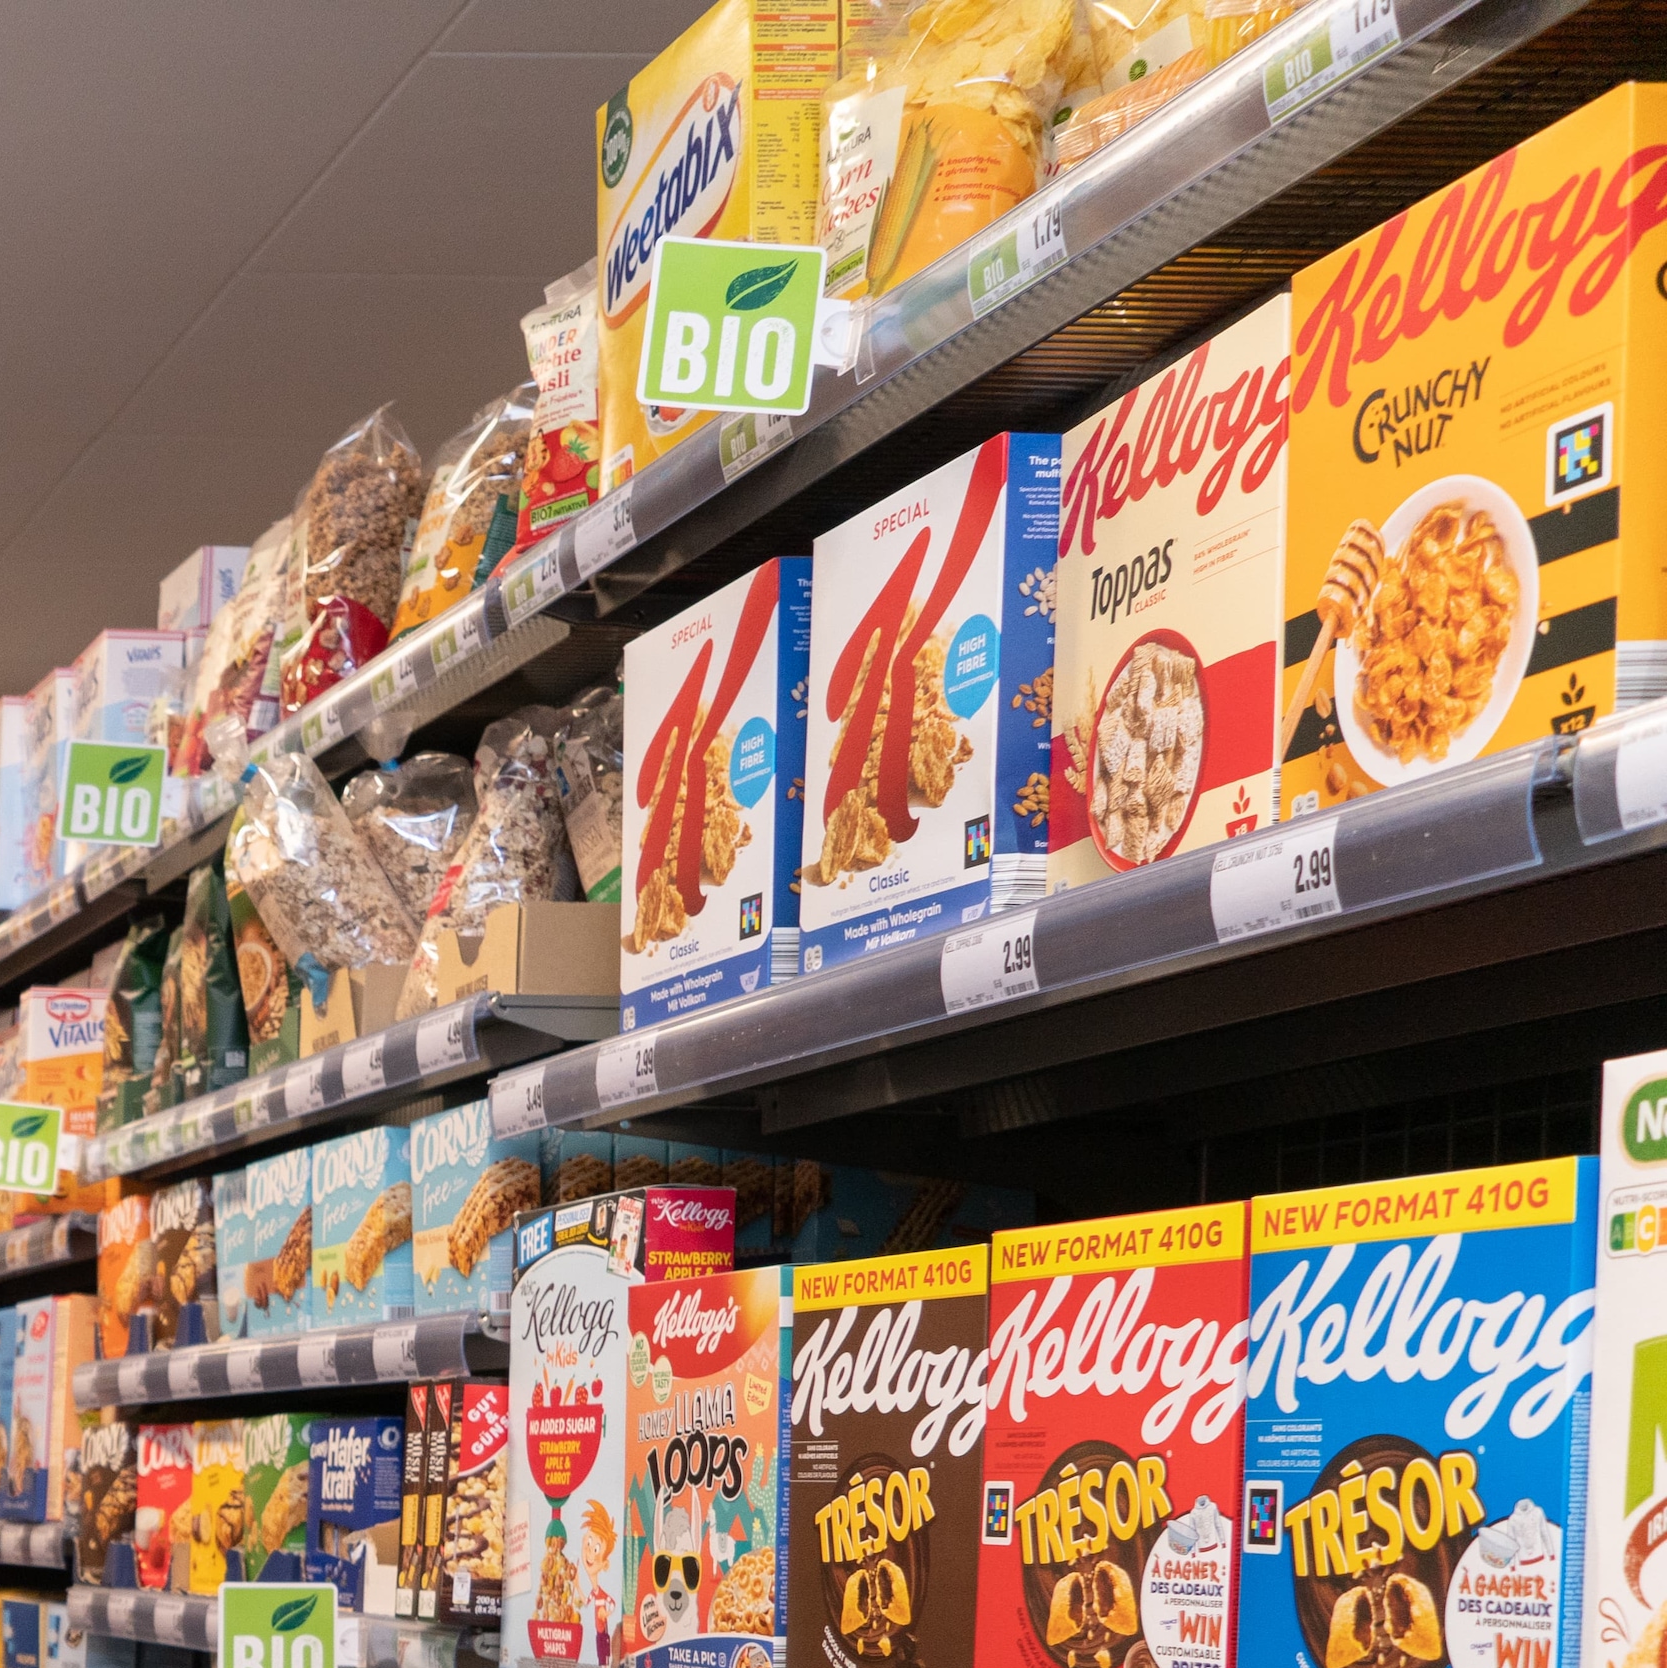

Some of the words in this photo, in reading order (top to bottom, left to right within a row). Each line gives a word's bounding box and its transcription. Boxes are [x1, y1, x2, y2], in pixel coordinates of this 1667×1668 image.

[1033, 210, 1061, 248] 1.79
[660, 310, 795, 401] BIO
[873, 499, 930, 541] SPECIAL
[1089, 536, 1175, 625] Toppas
[956, 654, 987, 675] FIBRE
[958, 635, 987, 658] HIGH
[70, 784, 151, 837] BIO
[868, 868, 910, 892] Classic
[1293, 848, 1331, 893] 2.99
[1003, 934, 1031, 975] 2.99
[1263, 1205, 1328, 1238] NEW
[1333, 1189, 1459, 1228] FORMAT
[1466, 1176, 1549, 1216] 410G
[523, 1297, 617, 1358] Kellogg
[530, 1419, 544, 1434] NO
[546, 1417, 571, 1434] ADDED
[573, 1416, 596, 1433] SUGAR
[327, 1429, 370, 1466] Hafer
[646, 1432, 749, 1504] LOOPS
[321, 1467, 358, 1501] kraft
[1458, 1602, 1483, 1616] DES
[1488, 1602, 1551, 1618] CADEAUX
